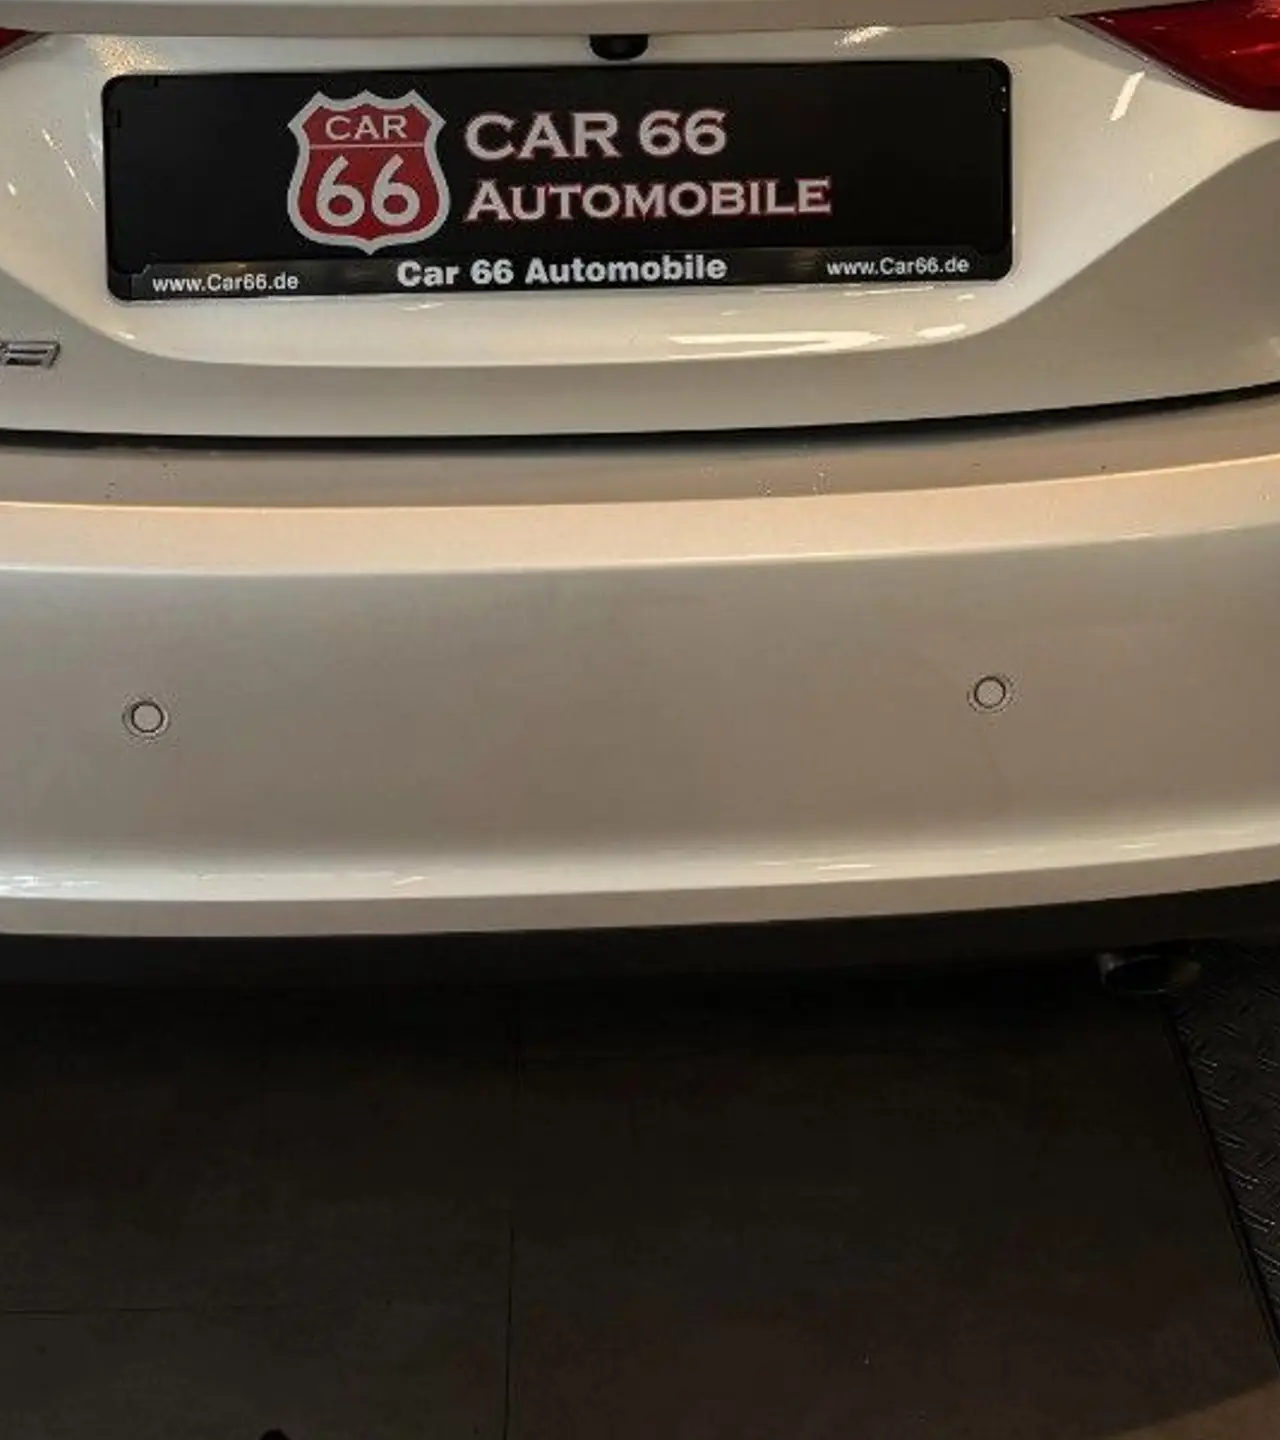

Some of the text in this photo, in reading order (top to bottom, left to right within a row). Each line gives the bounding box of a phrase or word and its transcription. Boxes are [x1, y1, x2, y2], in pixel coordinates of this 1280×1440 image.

[324, 114, 408, 142] CAR
[464, 108, 728, 160] CAR 66
[318, 153, 421, 228] 66
[463, 176, 833, 224] AUTOMOBILE
[151, 271, 300, 293] www.Car66.de
[396, 253, 729, 288] Car 66 Automobile
[825, 256, 971, 276] www.Car66.de
